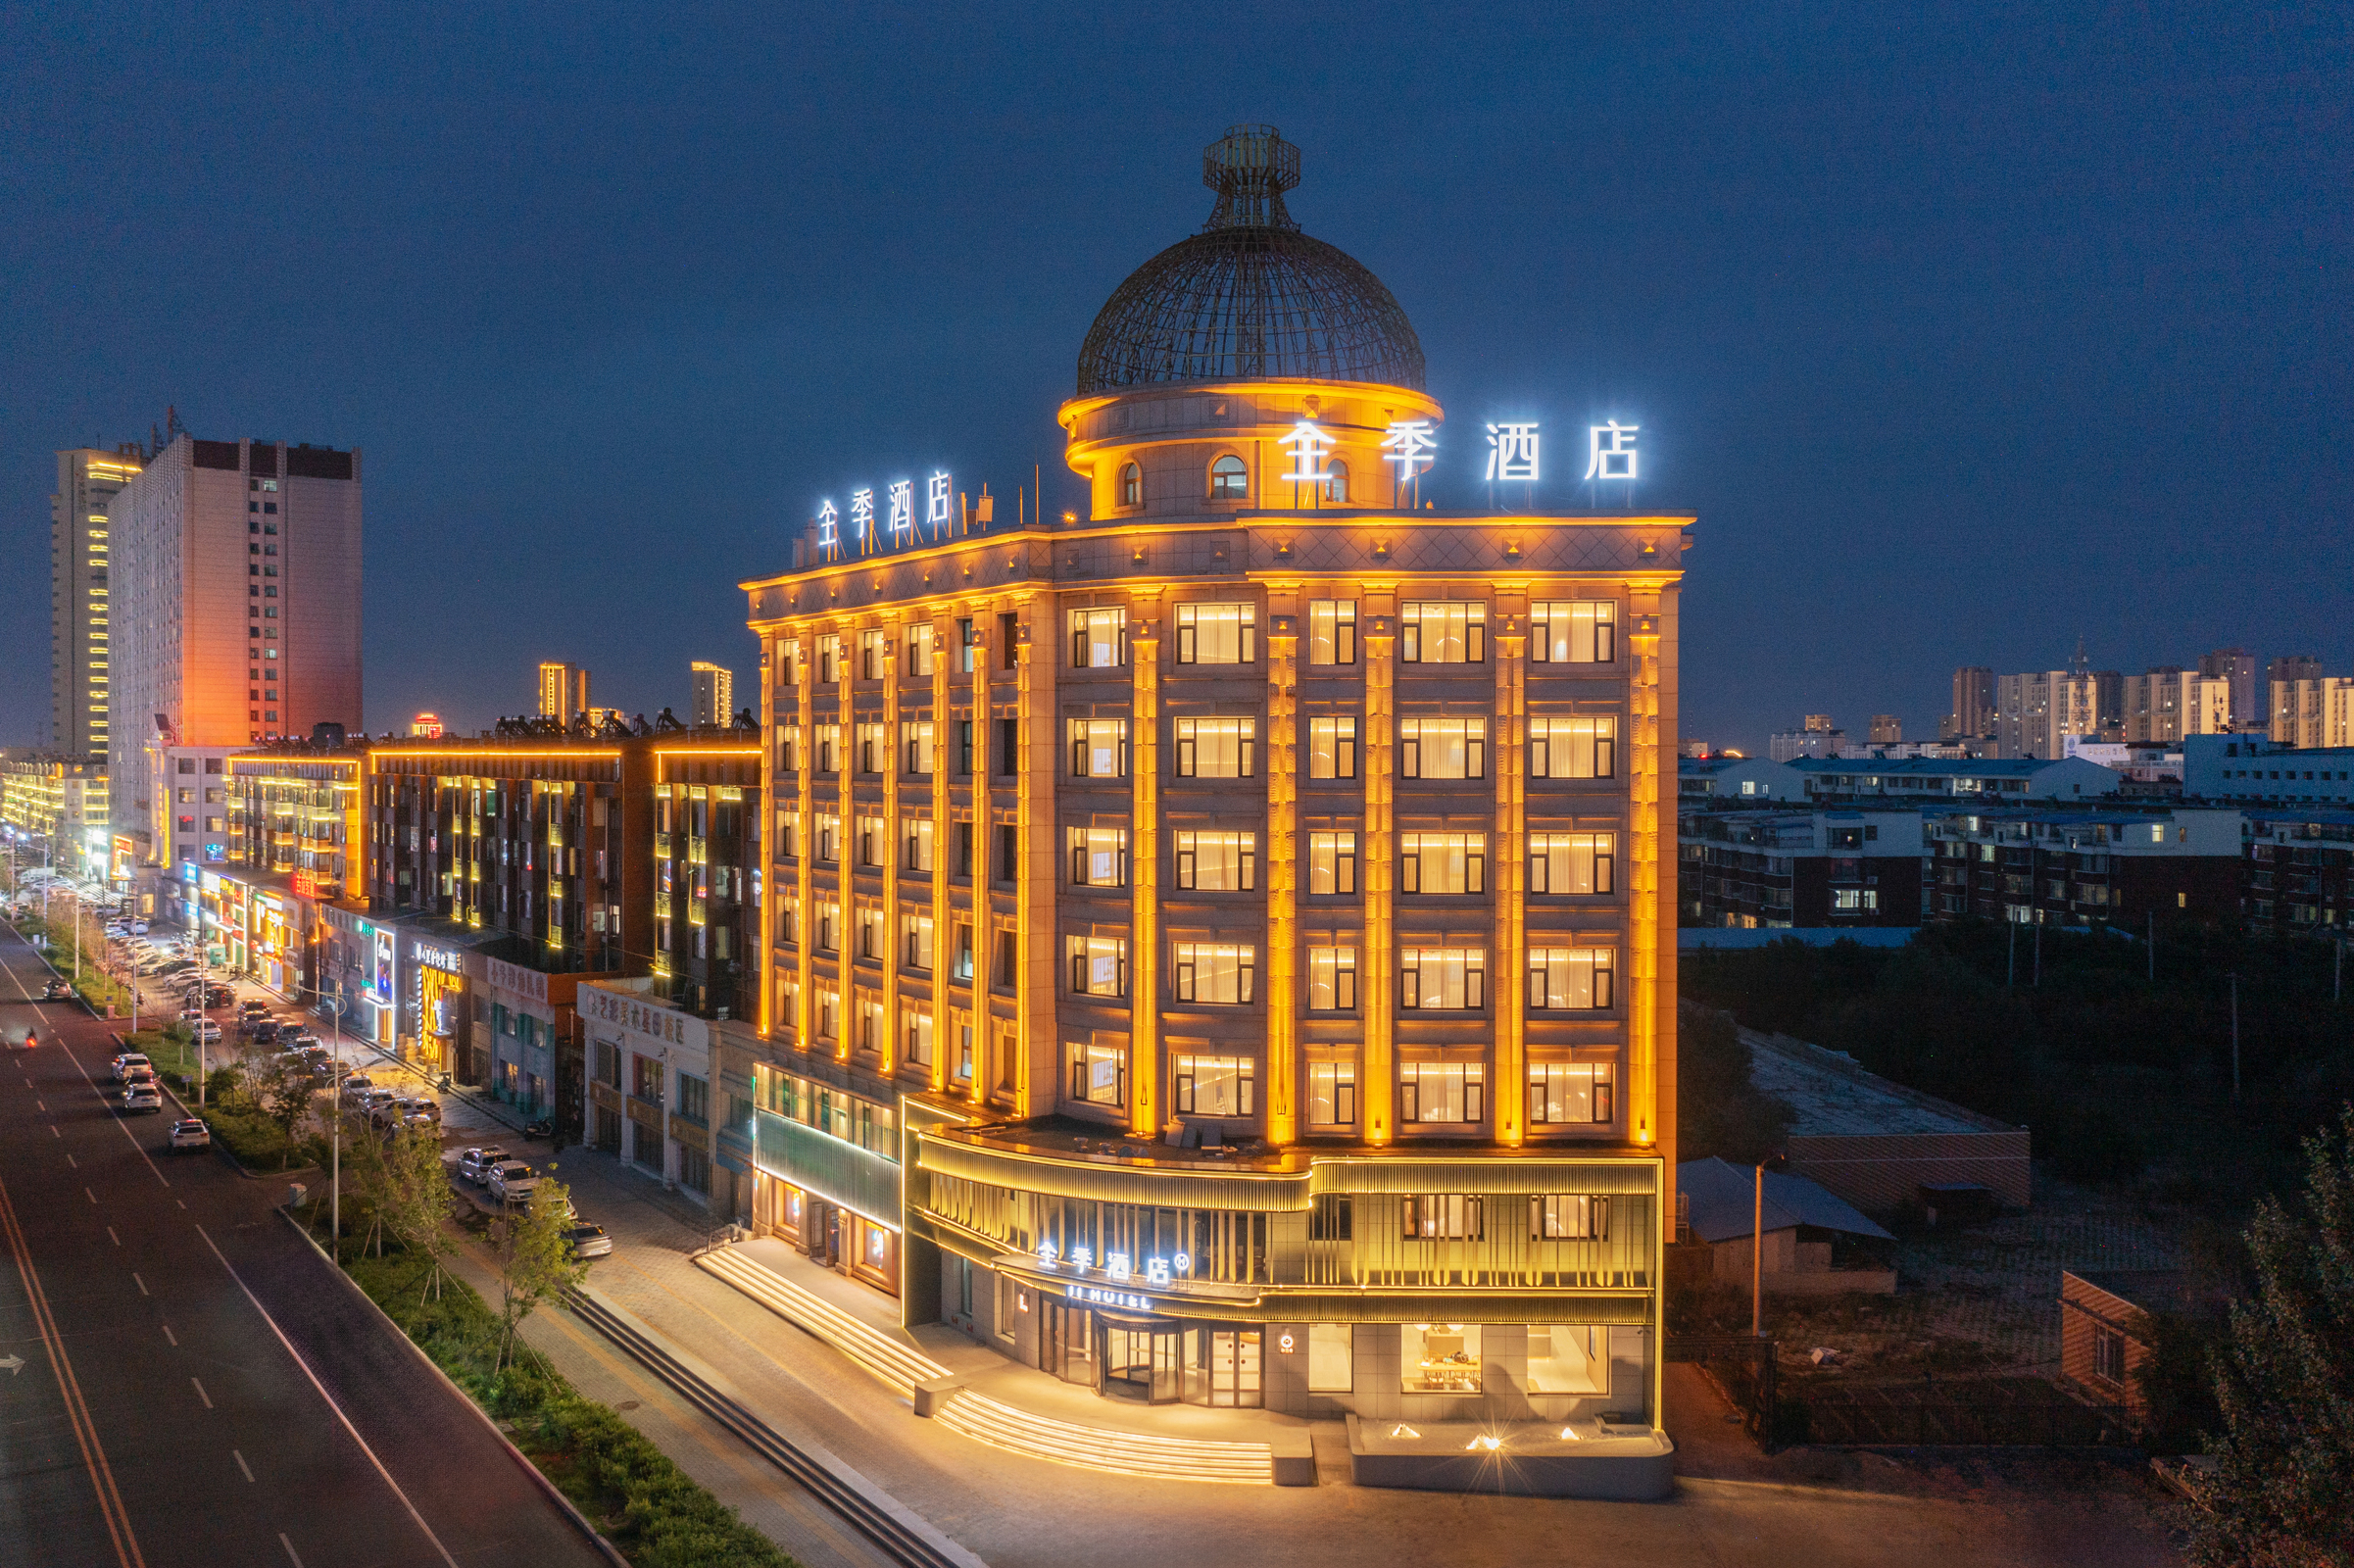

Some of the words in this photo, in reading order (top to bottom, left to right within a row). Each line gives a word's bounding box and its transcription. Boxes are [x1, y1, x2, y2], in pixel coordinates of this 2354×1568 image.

[1278, 418, 1640, 481] 全季酒店
[818, 470, 949, 546] 全季酒店
[1038, 1241, 1169, 1285] 全季酒店
